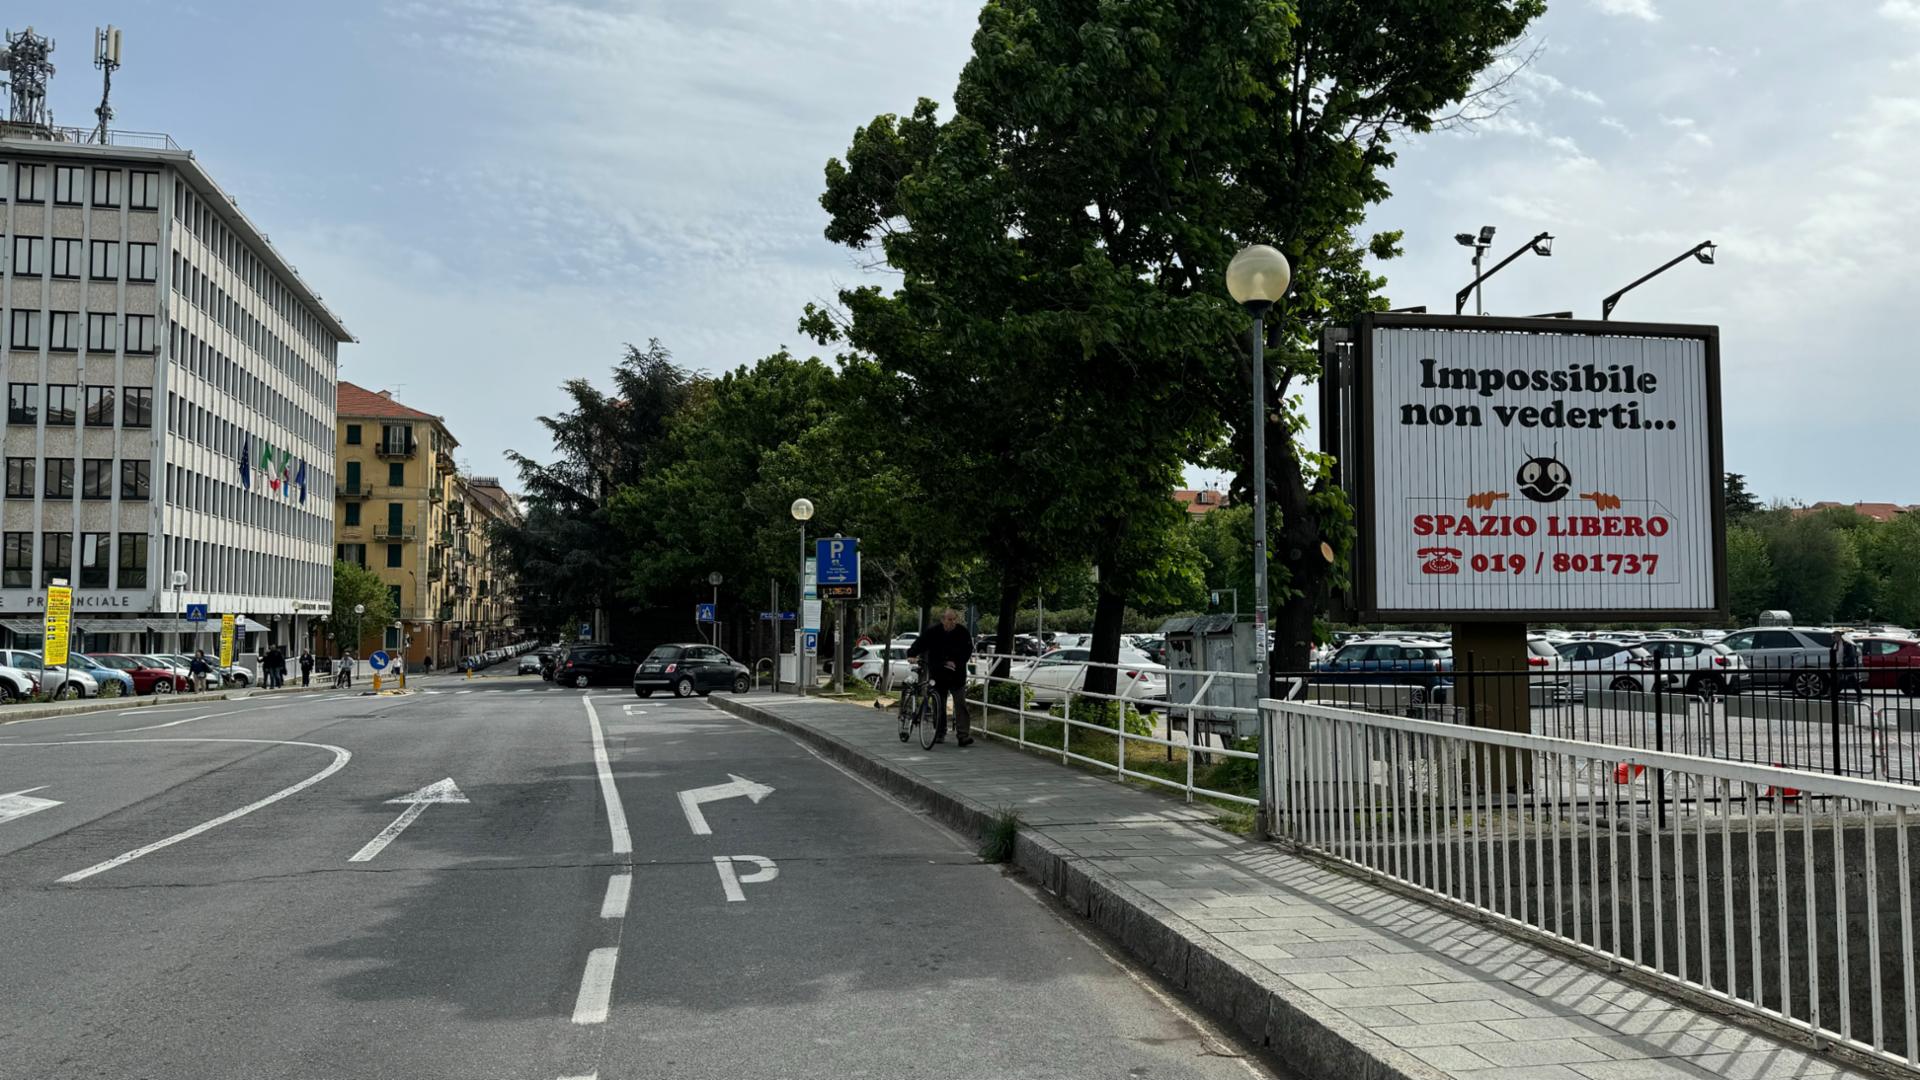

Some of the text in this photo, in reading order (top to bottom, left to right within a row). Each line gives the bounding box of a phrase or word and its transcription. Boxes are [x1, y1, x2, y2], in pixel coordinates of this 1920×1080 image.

[1420, 358, 1657, 397] Impossibile
[1400, 400, 1676, 430] non vederti...
[1413, 514, 1669, 538] SPAZIO LIBERO
[1471, 551, 1659, 576] 019 / 801737
[712, 855, 779, 902] P
